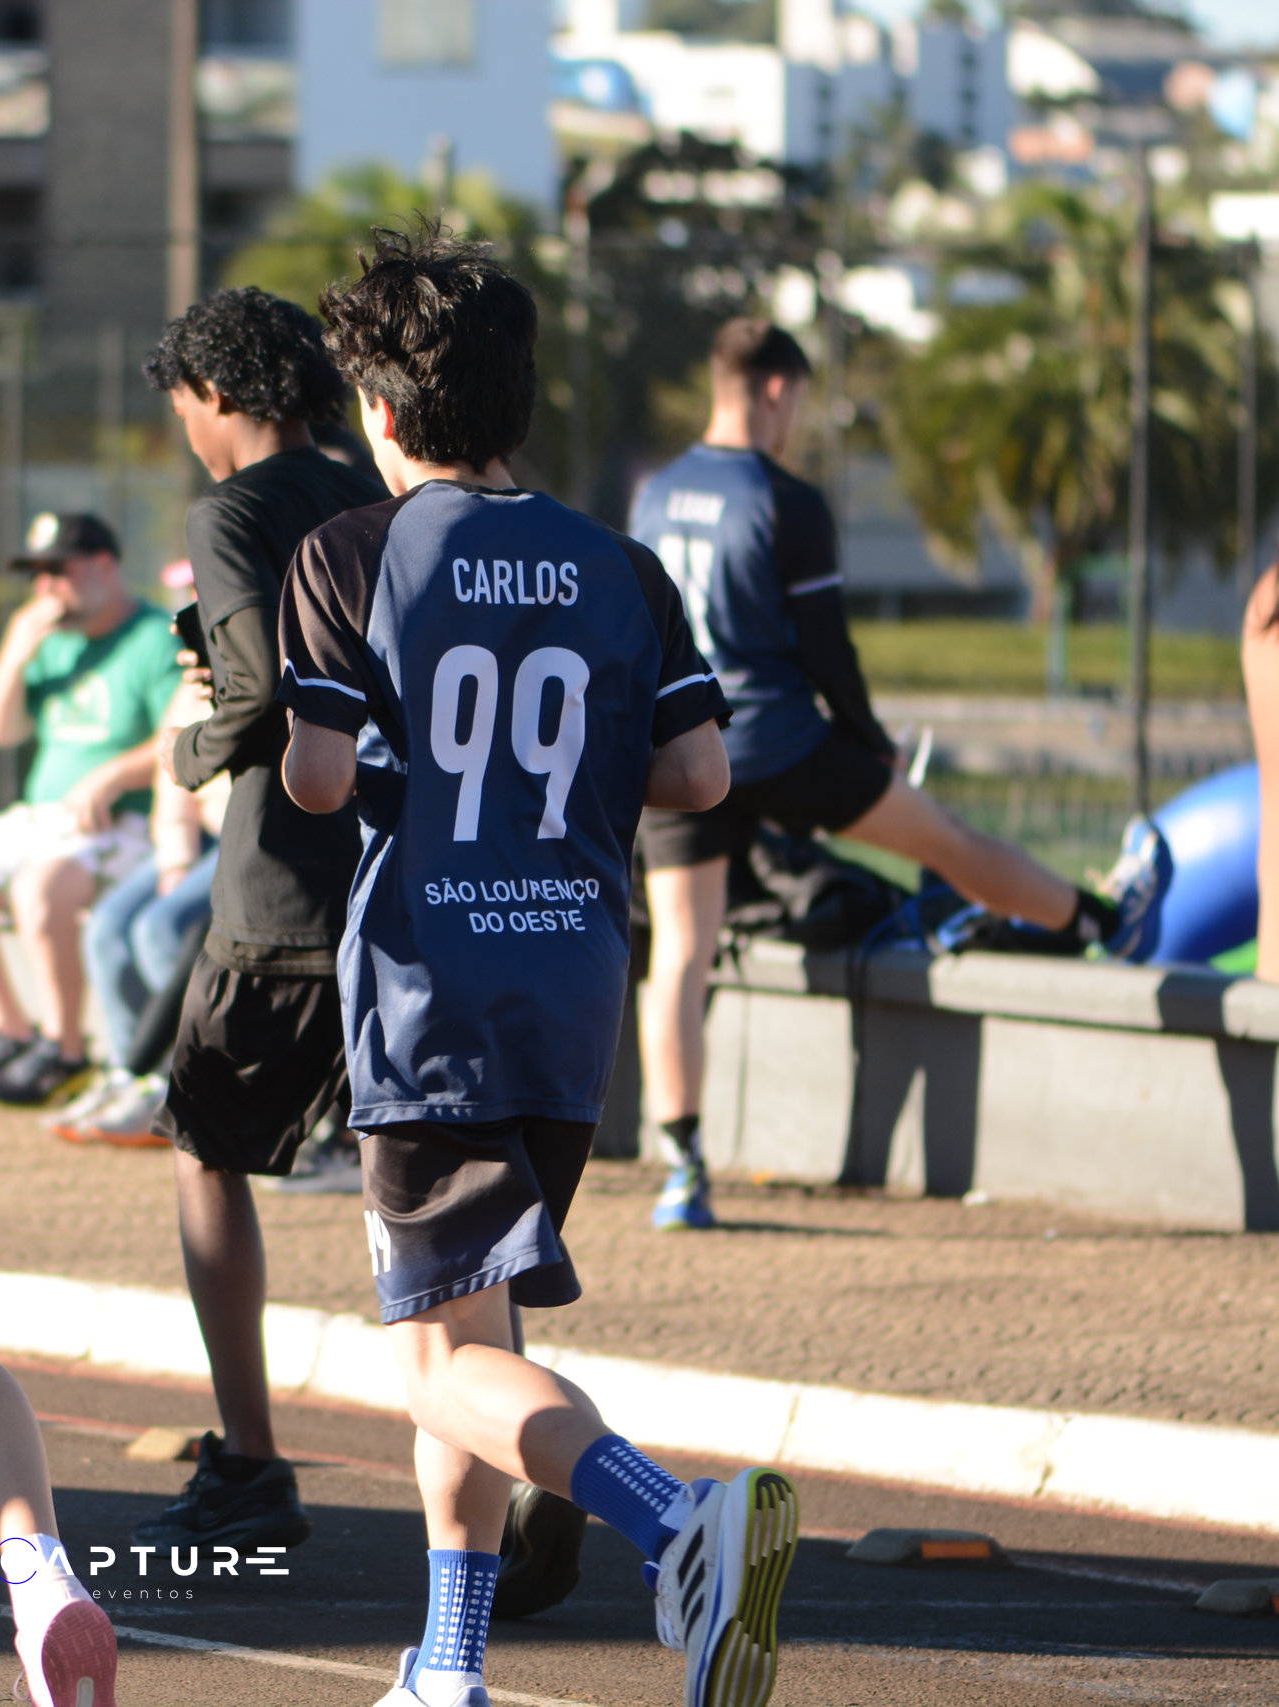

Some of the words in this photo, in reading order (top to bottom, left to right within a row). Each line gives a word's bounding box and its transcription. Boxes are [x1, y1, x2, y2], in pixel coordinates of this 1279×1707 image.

[452, 557, 579, 607] CARLOS
[429, 644, 591, 842] 99
[425, 877, 477, 905] SÃO
[480, 878, 600, 905] LOURENÇO
[469, 911, 504, 933] DO
[509, 909, 586, 932] OESTE
